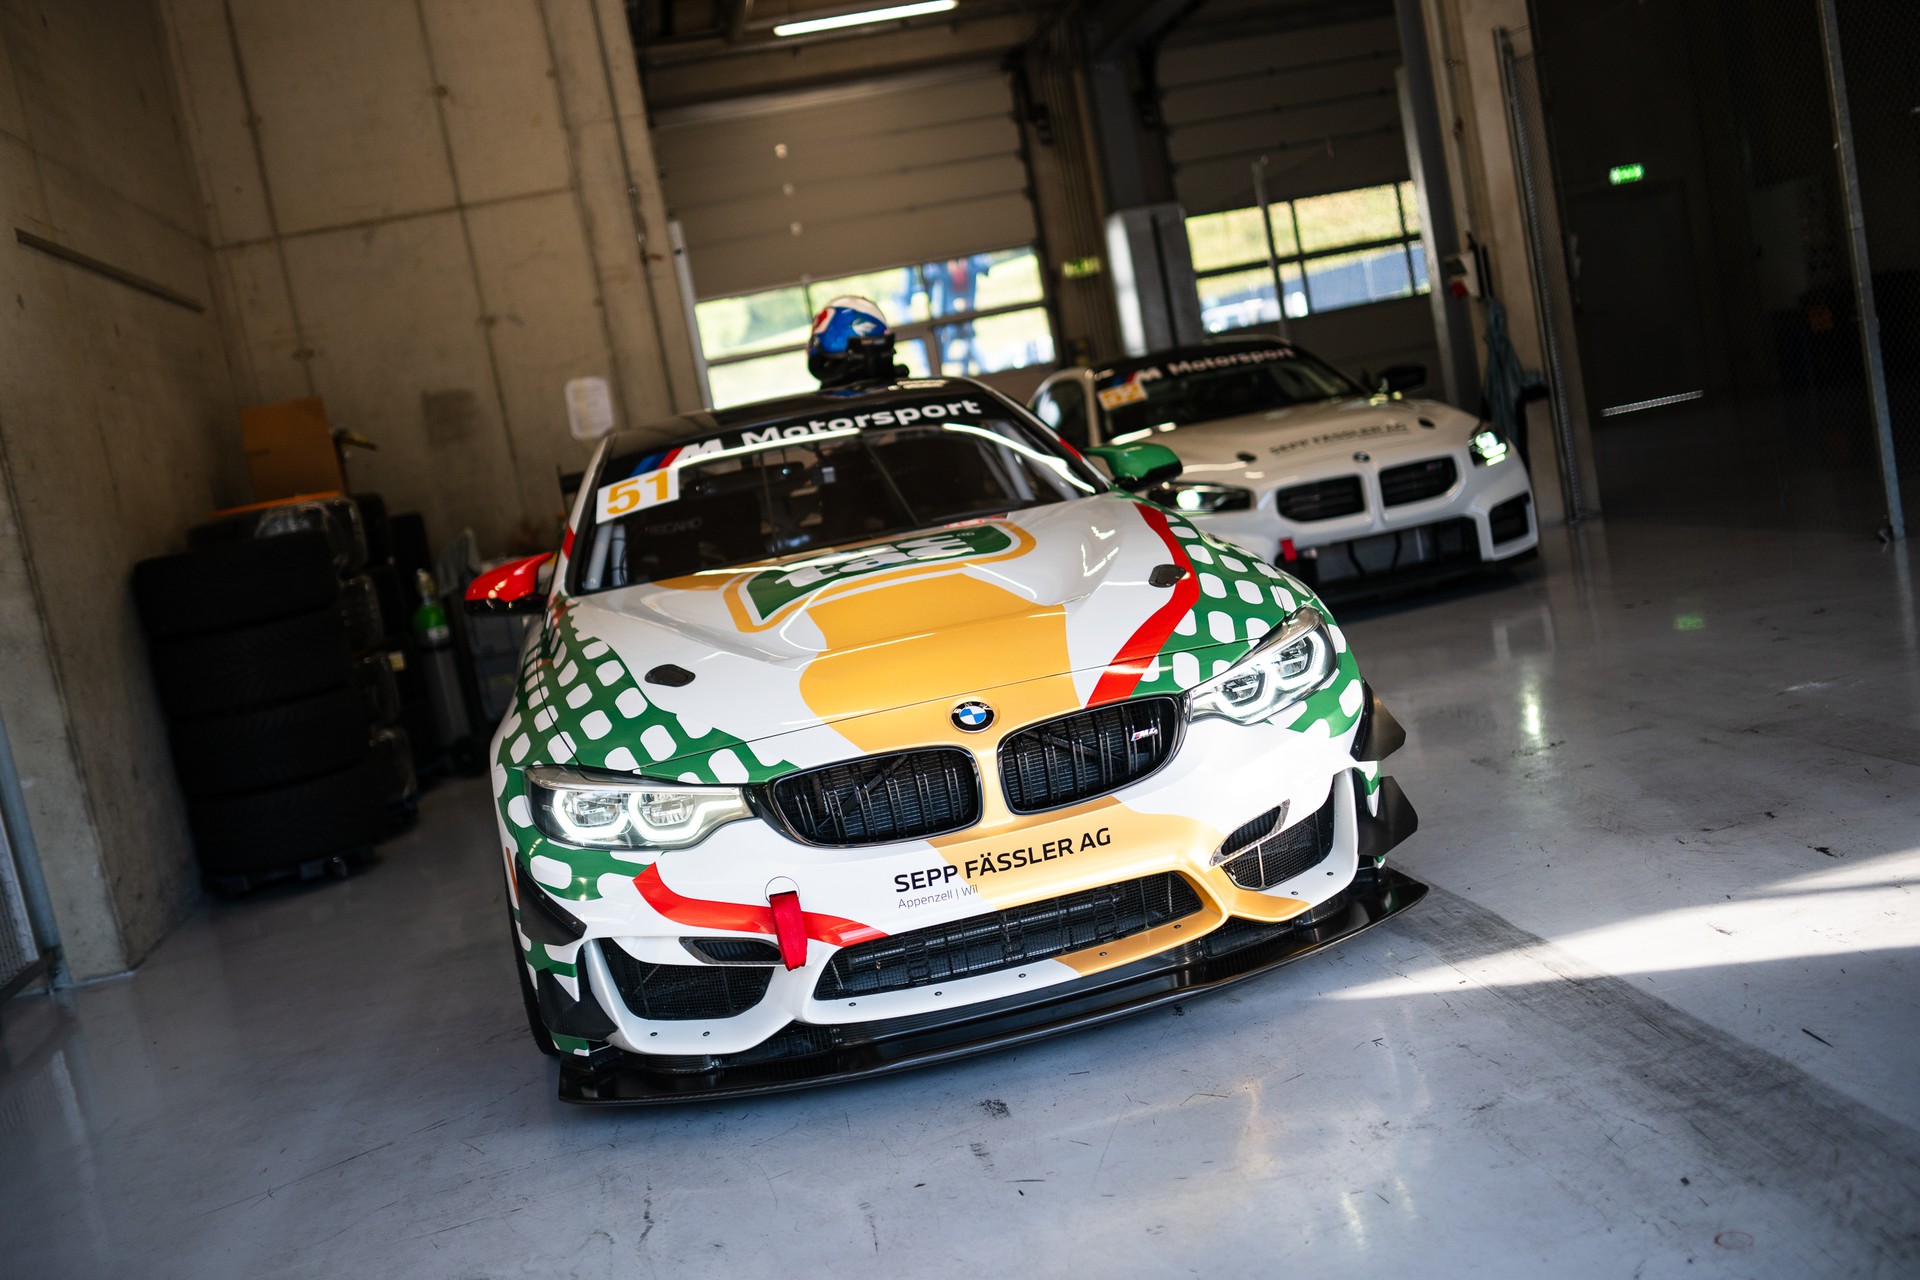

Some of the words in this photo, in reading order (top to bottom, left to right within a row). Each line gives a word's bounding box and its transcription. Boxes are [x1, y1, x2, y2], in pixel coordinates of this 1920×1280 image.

[1167, 348, 1296, 376] Motorsport
[741, 400, 982, 446] Motorsport
[607, 470, 668, 515] 51
[894, 864, 958, 893] SEPP
[964, 837, 1074, 879] FÄSSLER
[1079, 827, 1111, 852] AG
[898, 891, 953, 909] Appenzell
[961, 885, 978, 897] Wil
